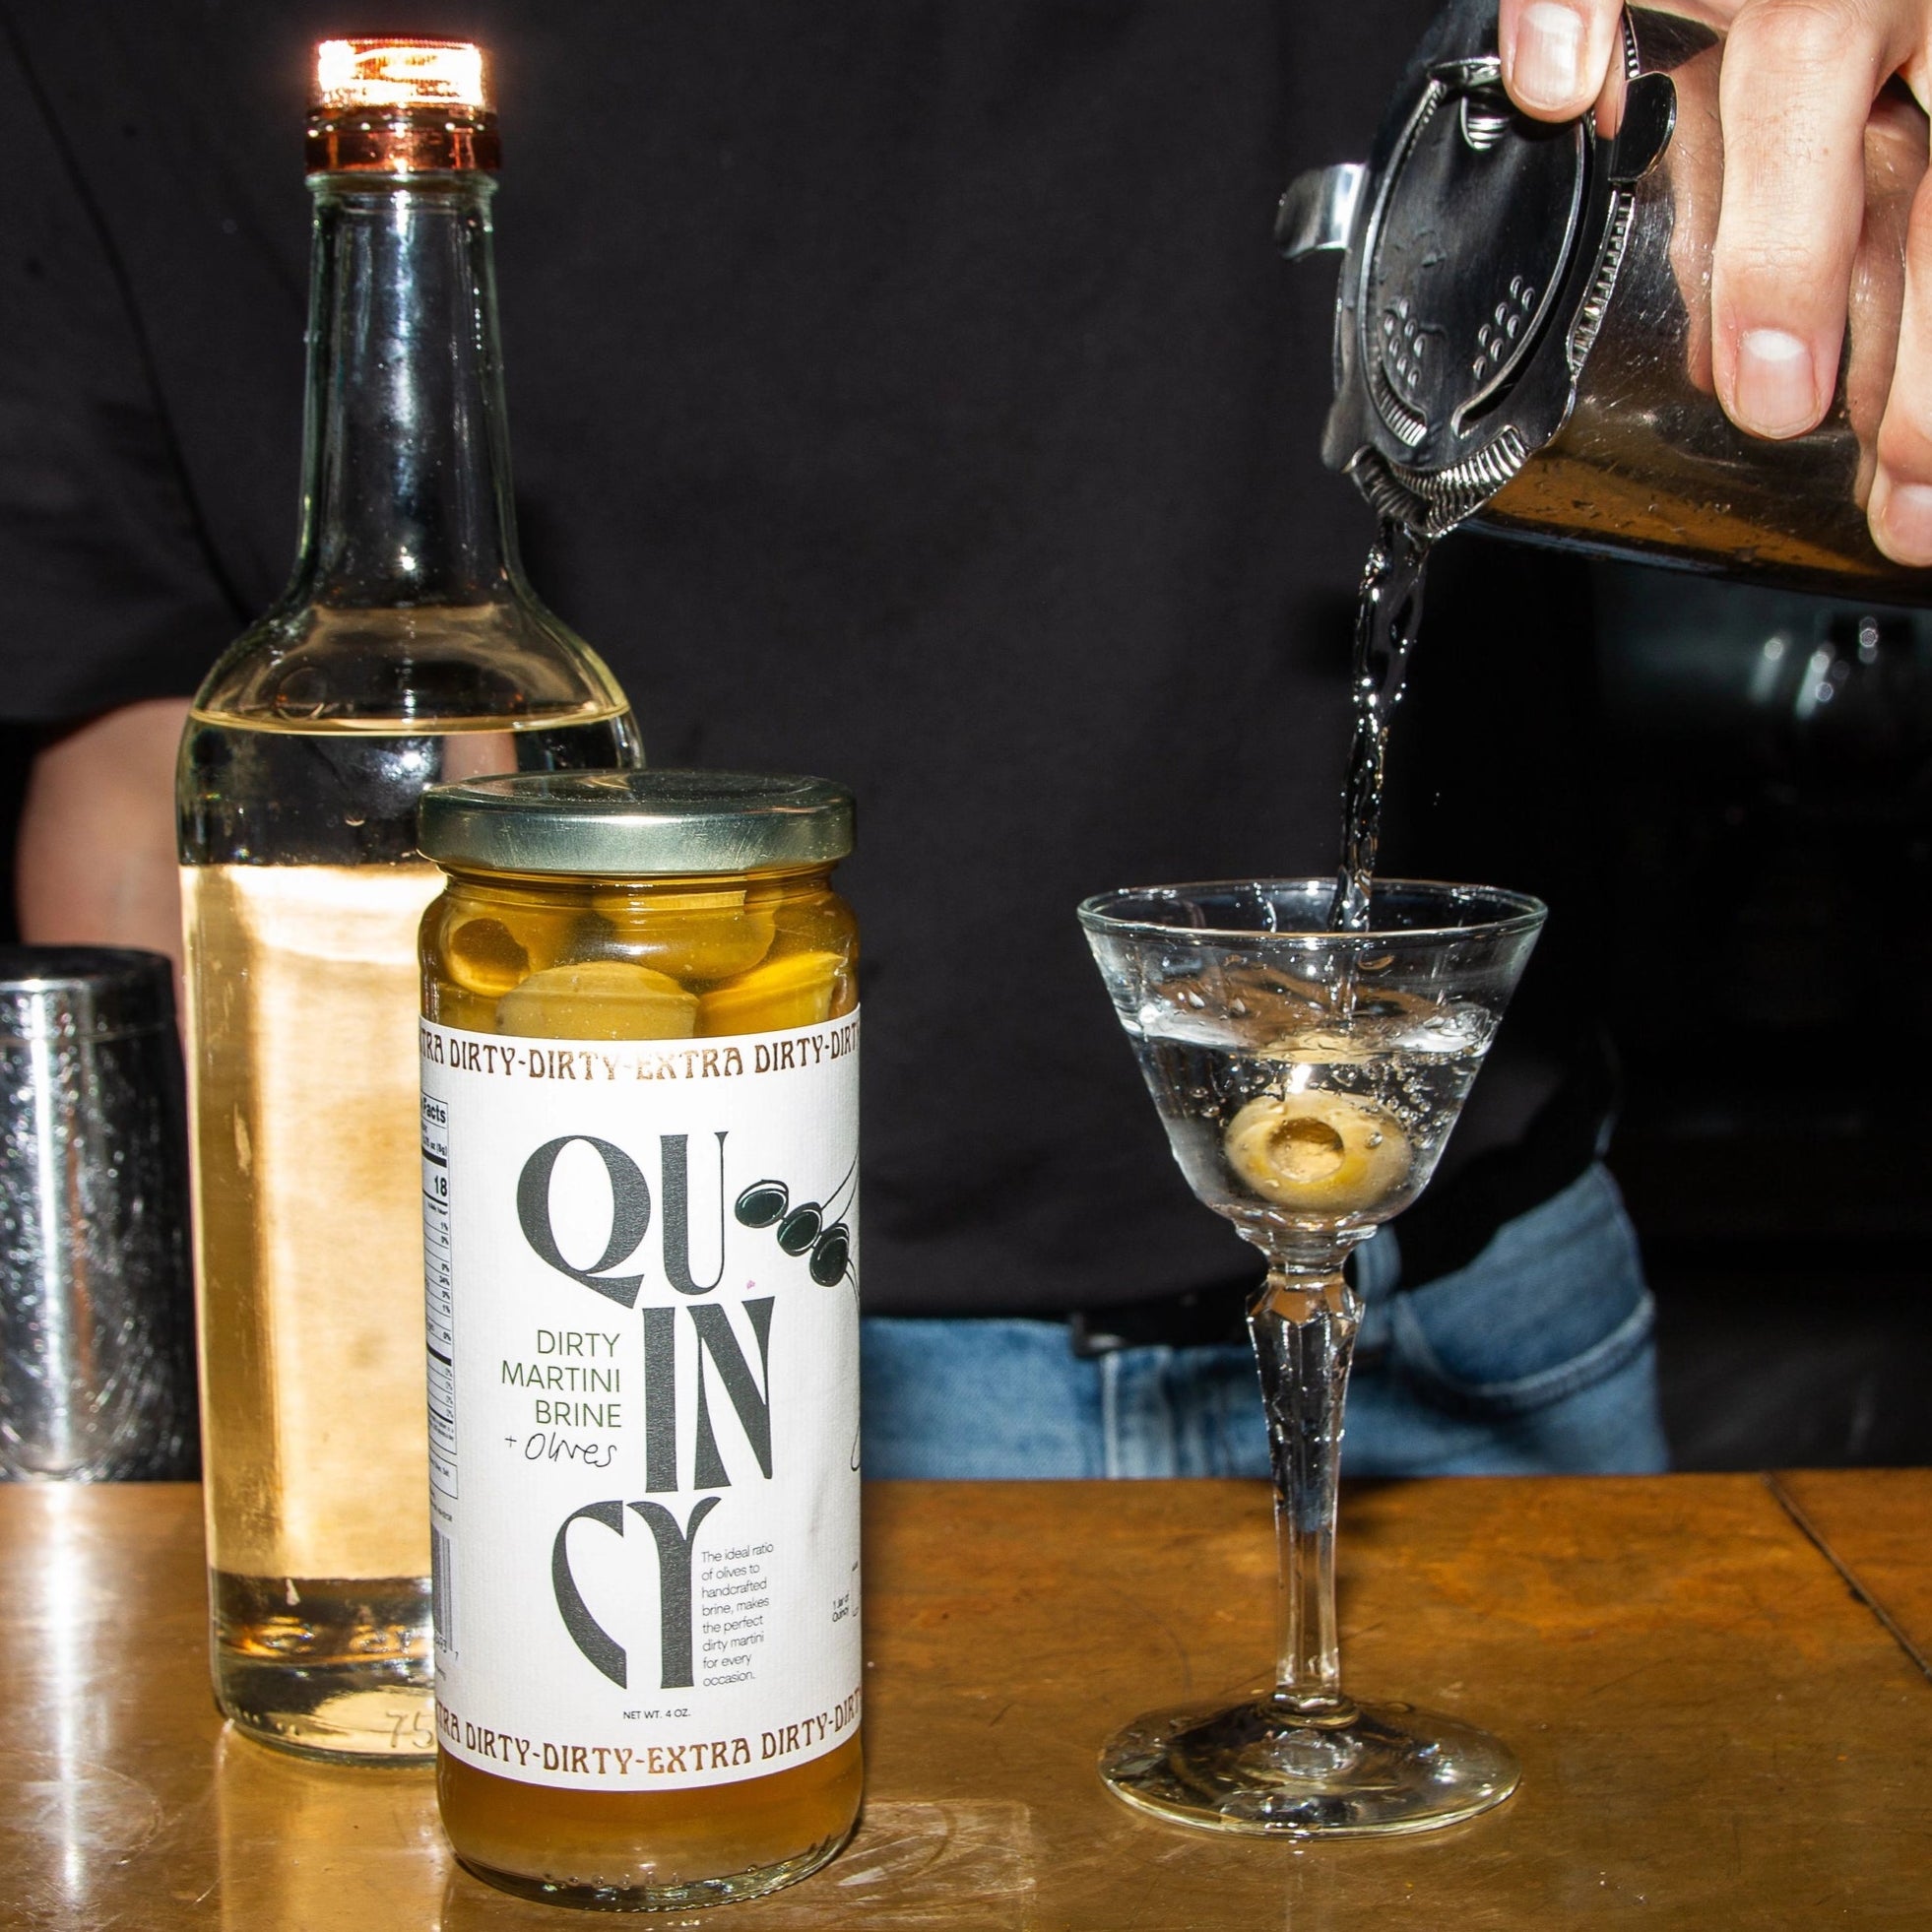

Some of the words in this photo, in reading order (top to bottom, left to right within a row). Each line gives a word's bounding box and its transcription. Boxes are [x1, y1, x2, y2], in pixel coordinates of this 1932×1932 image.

[754, 1020, 860, 1072] DIRTY-DIRT
[434, 1175, 447, 1196] 18
[537, 1329, 620, 1357] DIRTY
[501, 1360, 620, 1392] MARTINI
[536, 1399, 622, 1428] BRINE
[525, 1432, 617, 1467] Olives
[701, 1551, 723, 1563] The
[725, 1545, 750, 1560] ideal
[752, 1542, 774, 1555] ratio
[701, 1568, 713, 1580] of
[716, 1566, 746, 1578] olives
[749, 1564, 760, 1574] to
[701, 1577, 767, 1598] handcrafted
[702, 1603, 734, 1616] brine,
[737, 1597, 770, 1611] makes
[702, 1622, 722, 1634] the
[724, 1616, 763, 1635] perfect
[702, 1639, 729, 1652] dirty
[731, 1631, 764, 1647] martini
[703, 1656, 718, 1669] for
[721, 1654, 752, 1666] every
[703, 1671, 756, 1687] occasion.
[622, 1710, 641, 1720] NET
[644, 1710, 663, 1719] WT.
[665, 1709, 672, 1718] 4
[674, 1708, 691, 1717] OZ.
[761, 1686, 862, 1759] DIRTY-DIRT
